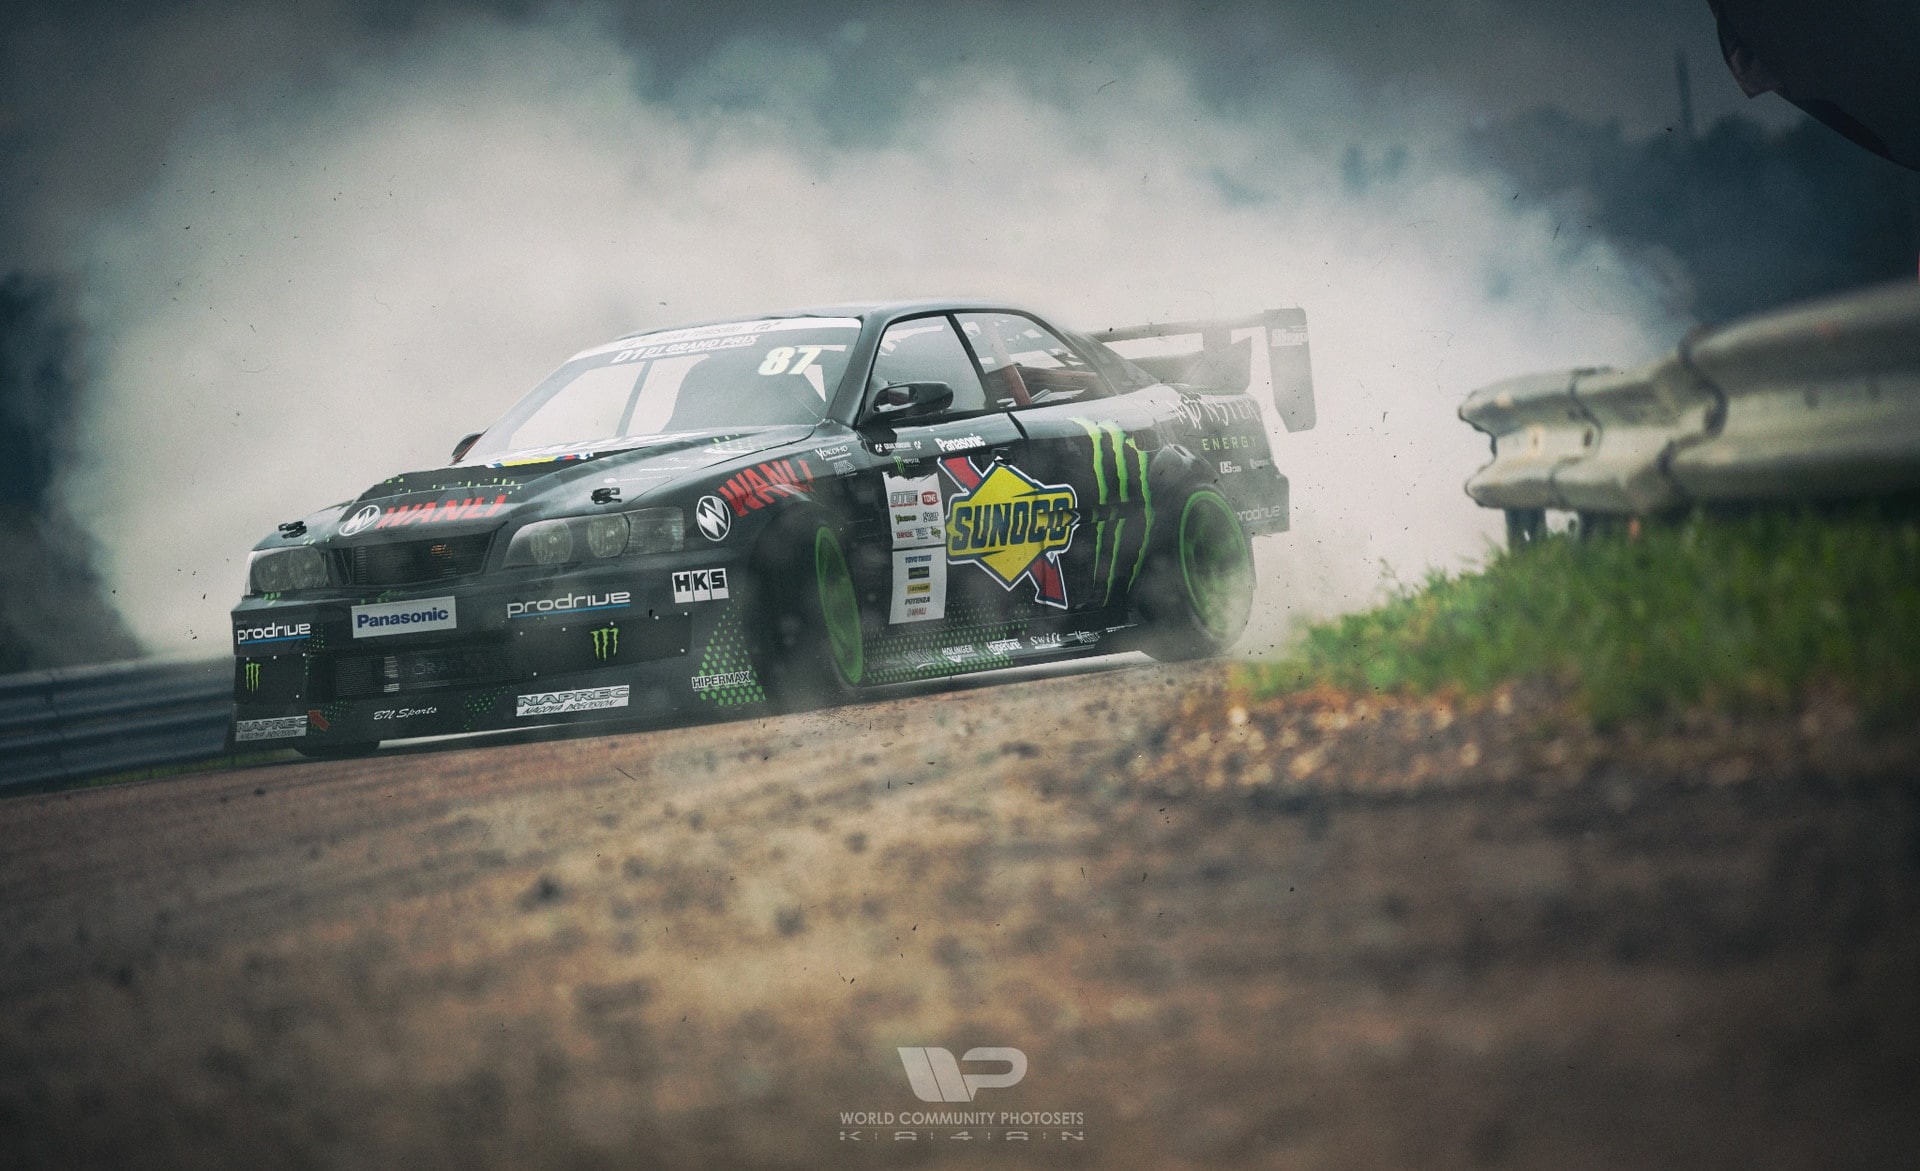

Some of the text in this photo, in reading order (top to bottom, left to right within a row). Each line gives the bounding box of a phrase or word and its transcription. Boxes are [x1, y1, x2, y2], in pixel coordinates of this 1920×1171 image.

[666, 339, 719, 353] GRAND
[719, 333, 761, 347] PRIX
[758, 346, 822, 376] 87
[934, 433, 986, 452] Panasonic
[1201, 434, 1257, 451] ENERGY
[375, 494, 507, 530] WANLI
[951, 498, 1071, 551] SUNOCO
[674, 569, 725, 594] HKS
[507, 590, 631, 618] prodrive
[357, 606, 449, 629] Panasonic
[237, 622, 312, 644] prodrive
[1030, 632, 1062, 646] Swift
[941, 644, 974, 656] HOLINGER
[692, 670, 751, 689] HIPERMAX
[518, 687, 629, 707] NAPREC
[396, 706, 438, 719] Sports
[236, 717, 308, 733] NAPREC
